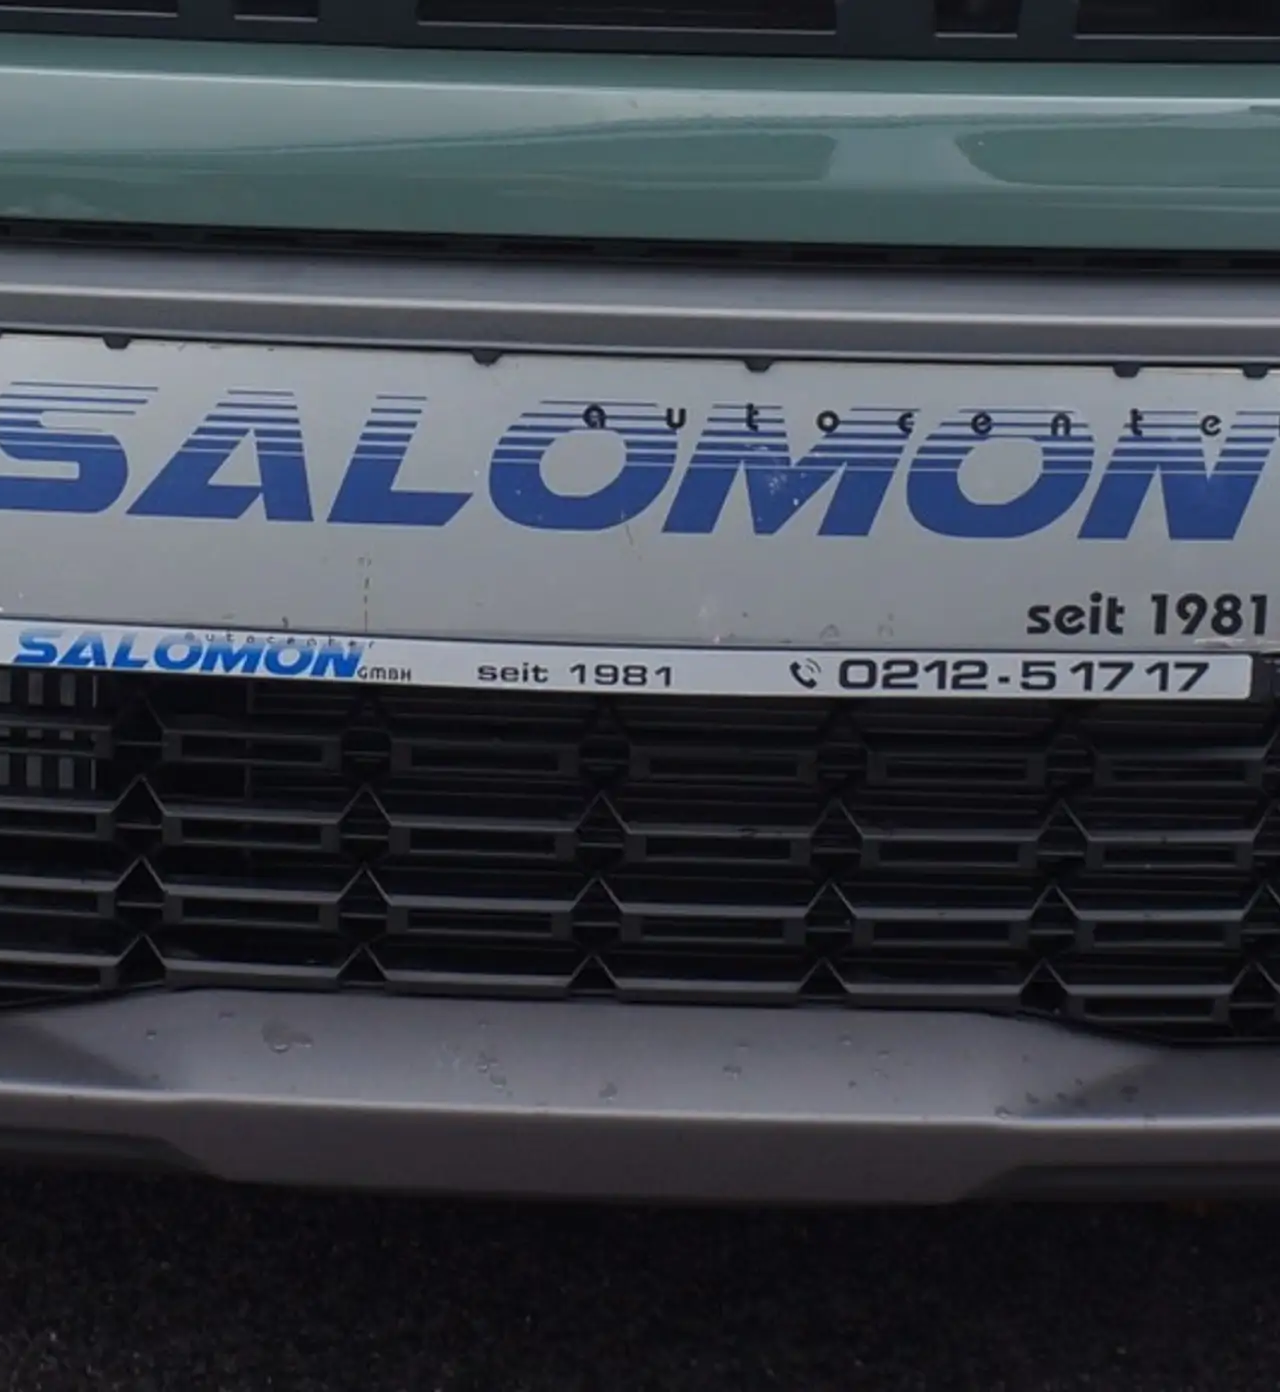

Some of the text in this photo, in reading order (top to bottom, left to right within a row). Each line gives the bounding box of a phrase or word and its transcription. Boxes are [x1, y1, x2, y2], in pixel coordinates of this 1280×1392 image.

[1026, 591, 1269, 637] seit 1981
[12, 627, 366, 679] SALOMON
[477, 663, 673, 687] seit 1981
